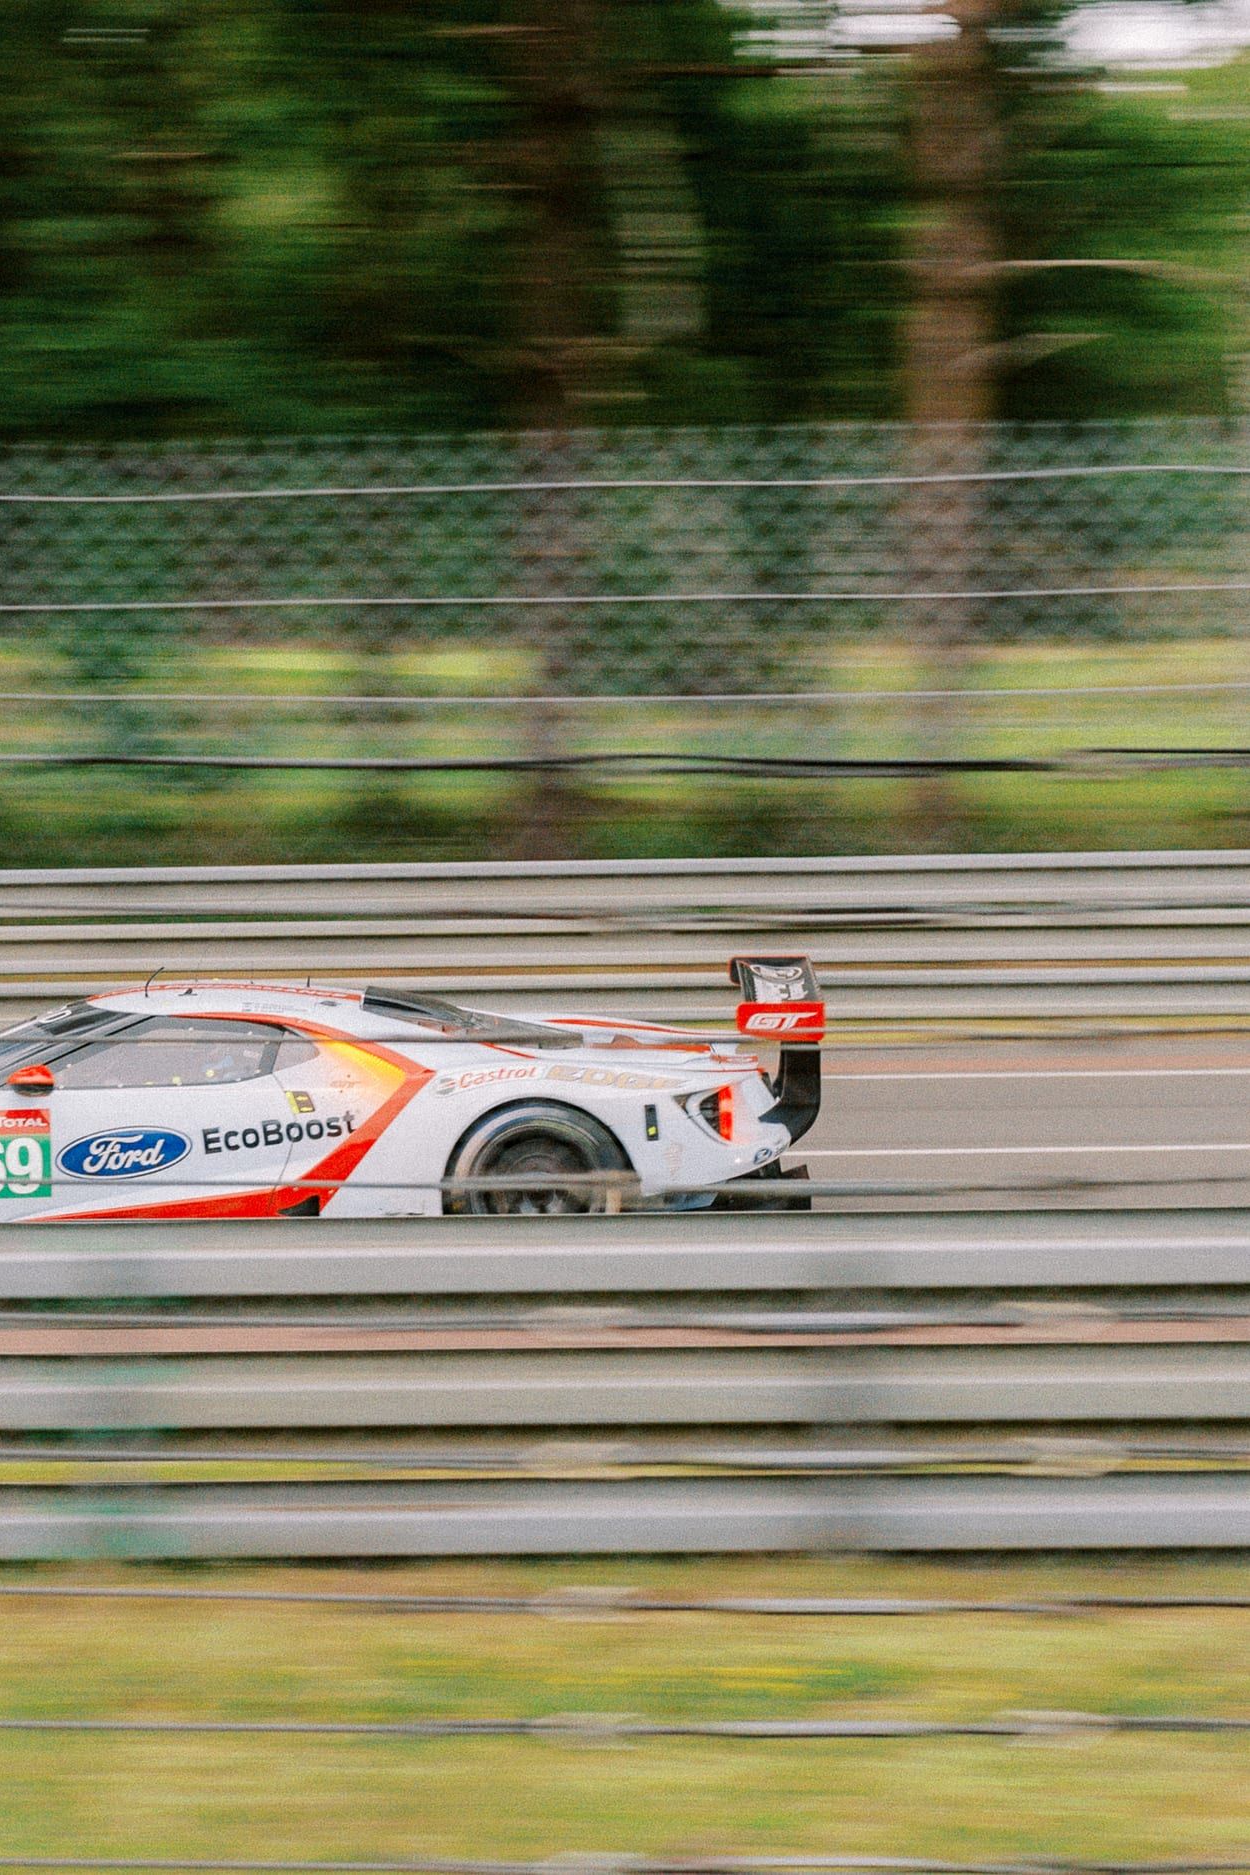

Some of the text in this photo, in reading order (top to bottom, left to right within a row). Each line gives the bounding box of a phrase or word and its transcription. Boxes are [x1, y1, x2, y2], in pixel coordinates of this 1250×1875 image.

[745, 1011, 819, 1032] GT
[458, 1066, 537, 1089] Castrol
[202, 1111, 356, 1155] EcoBoost
[82, 1134, 166, 1173] Ford
